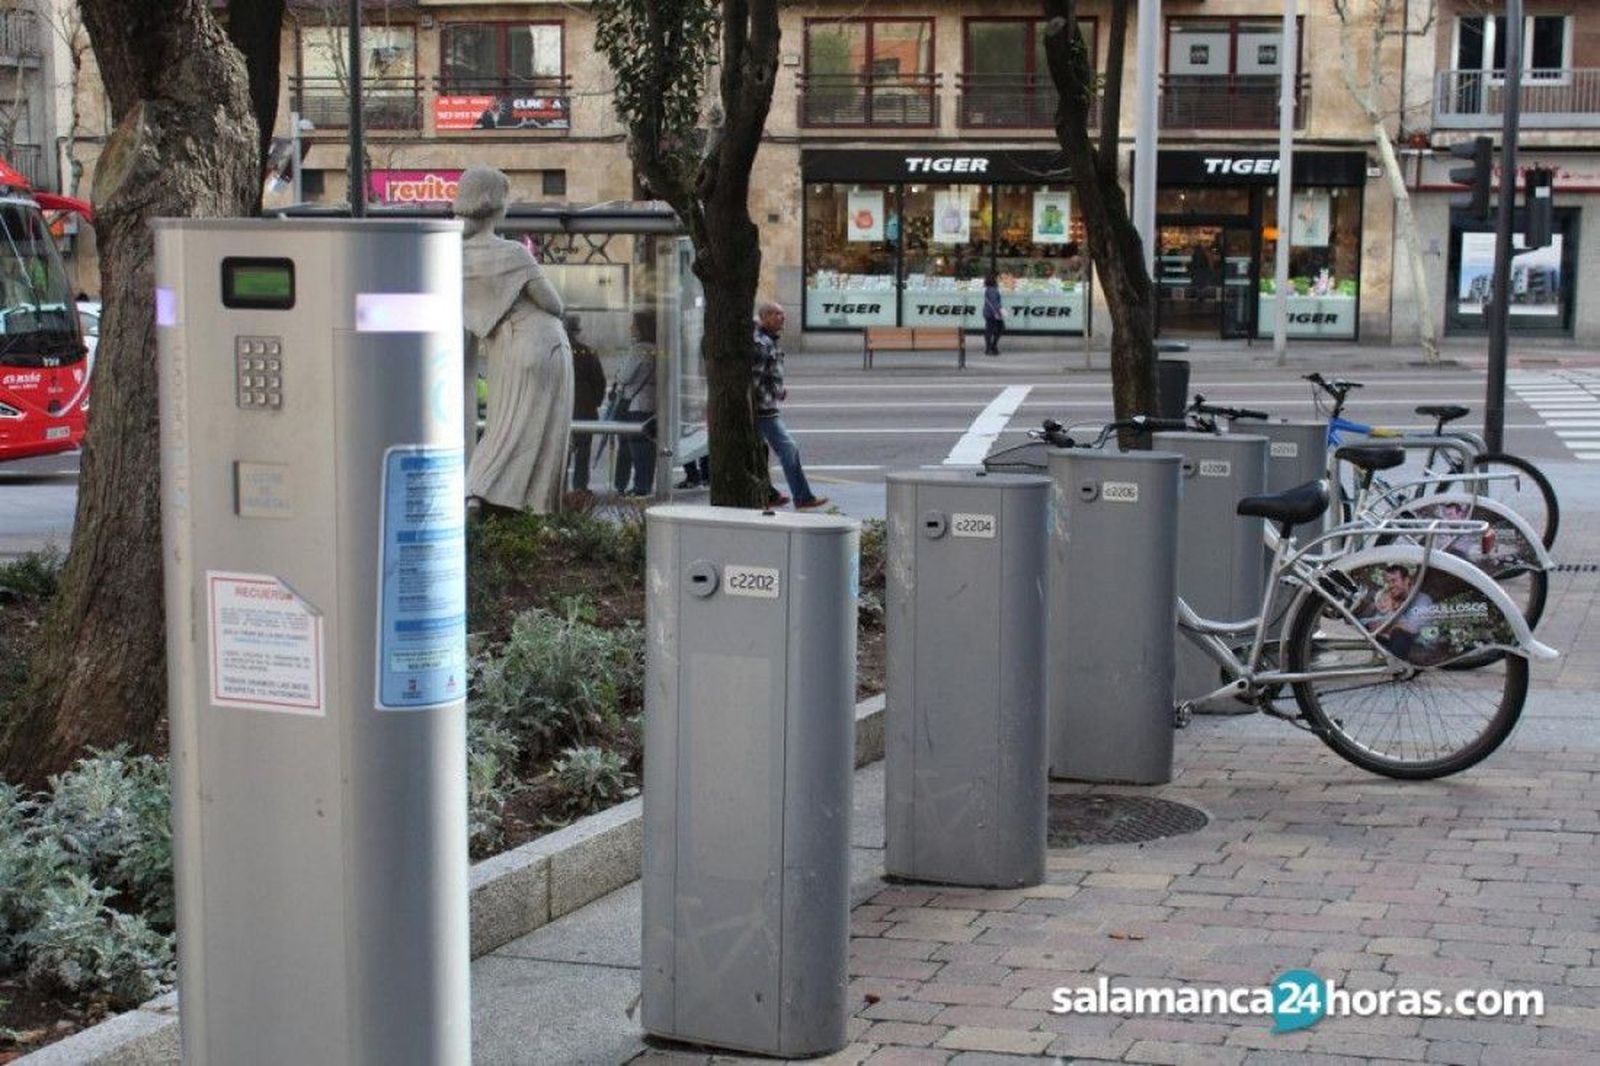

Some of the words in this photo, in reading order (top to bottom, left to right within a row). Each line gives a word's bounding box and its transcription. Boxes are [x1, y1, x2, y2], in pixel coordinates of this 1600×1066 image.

[904, 157, 990, 173] TIGER
[821, 302, 882, 315] TIGER
[915, 303, 977, 316] TIGER
[1010, 305, 1073, 318] TIGER
[955, 519, 991, 532] c2204
[729, 573, 775, 591] c2202
